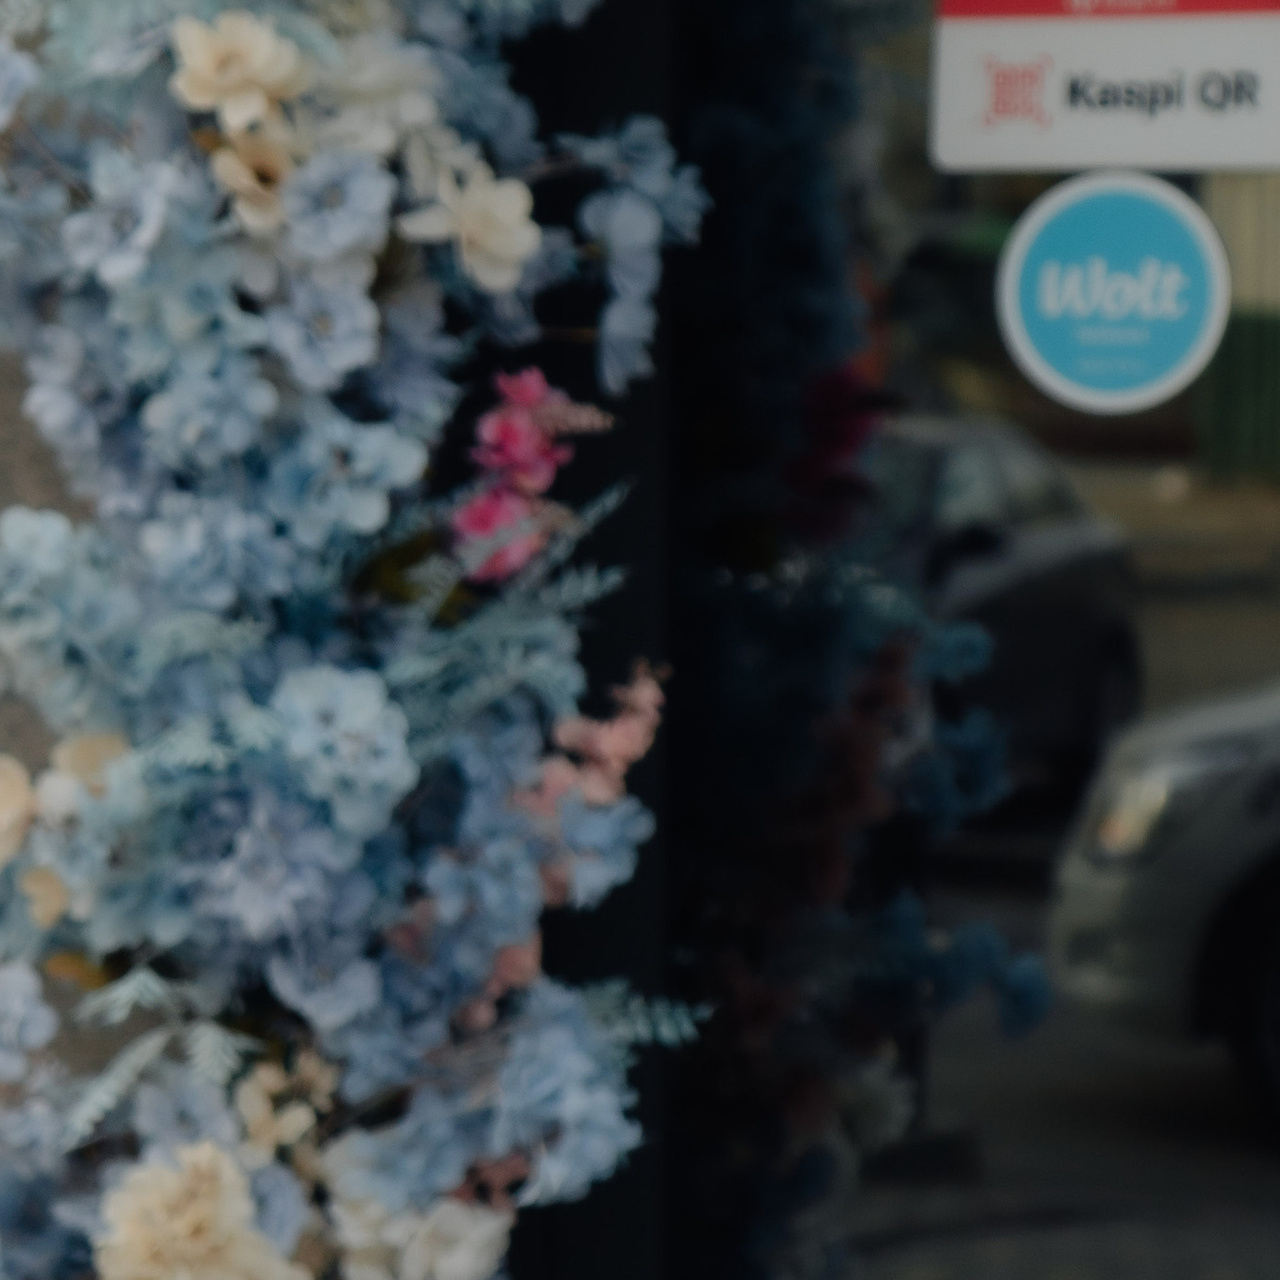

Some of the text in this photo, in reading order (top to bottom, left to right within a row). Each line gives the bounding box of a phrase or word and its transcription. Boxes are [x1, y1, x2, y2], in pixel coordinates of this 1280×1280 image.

[1067, 70, 1260, 116] Kaspi QR
[1040, 256, 1190, 320] Wolt
